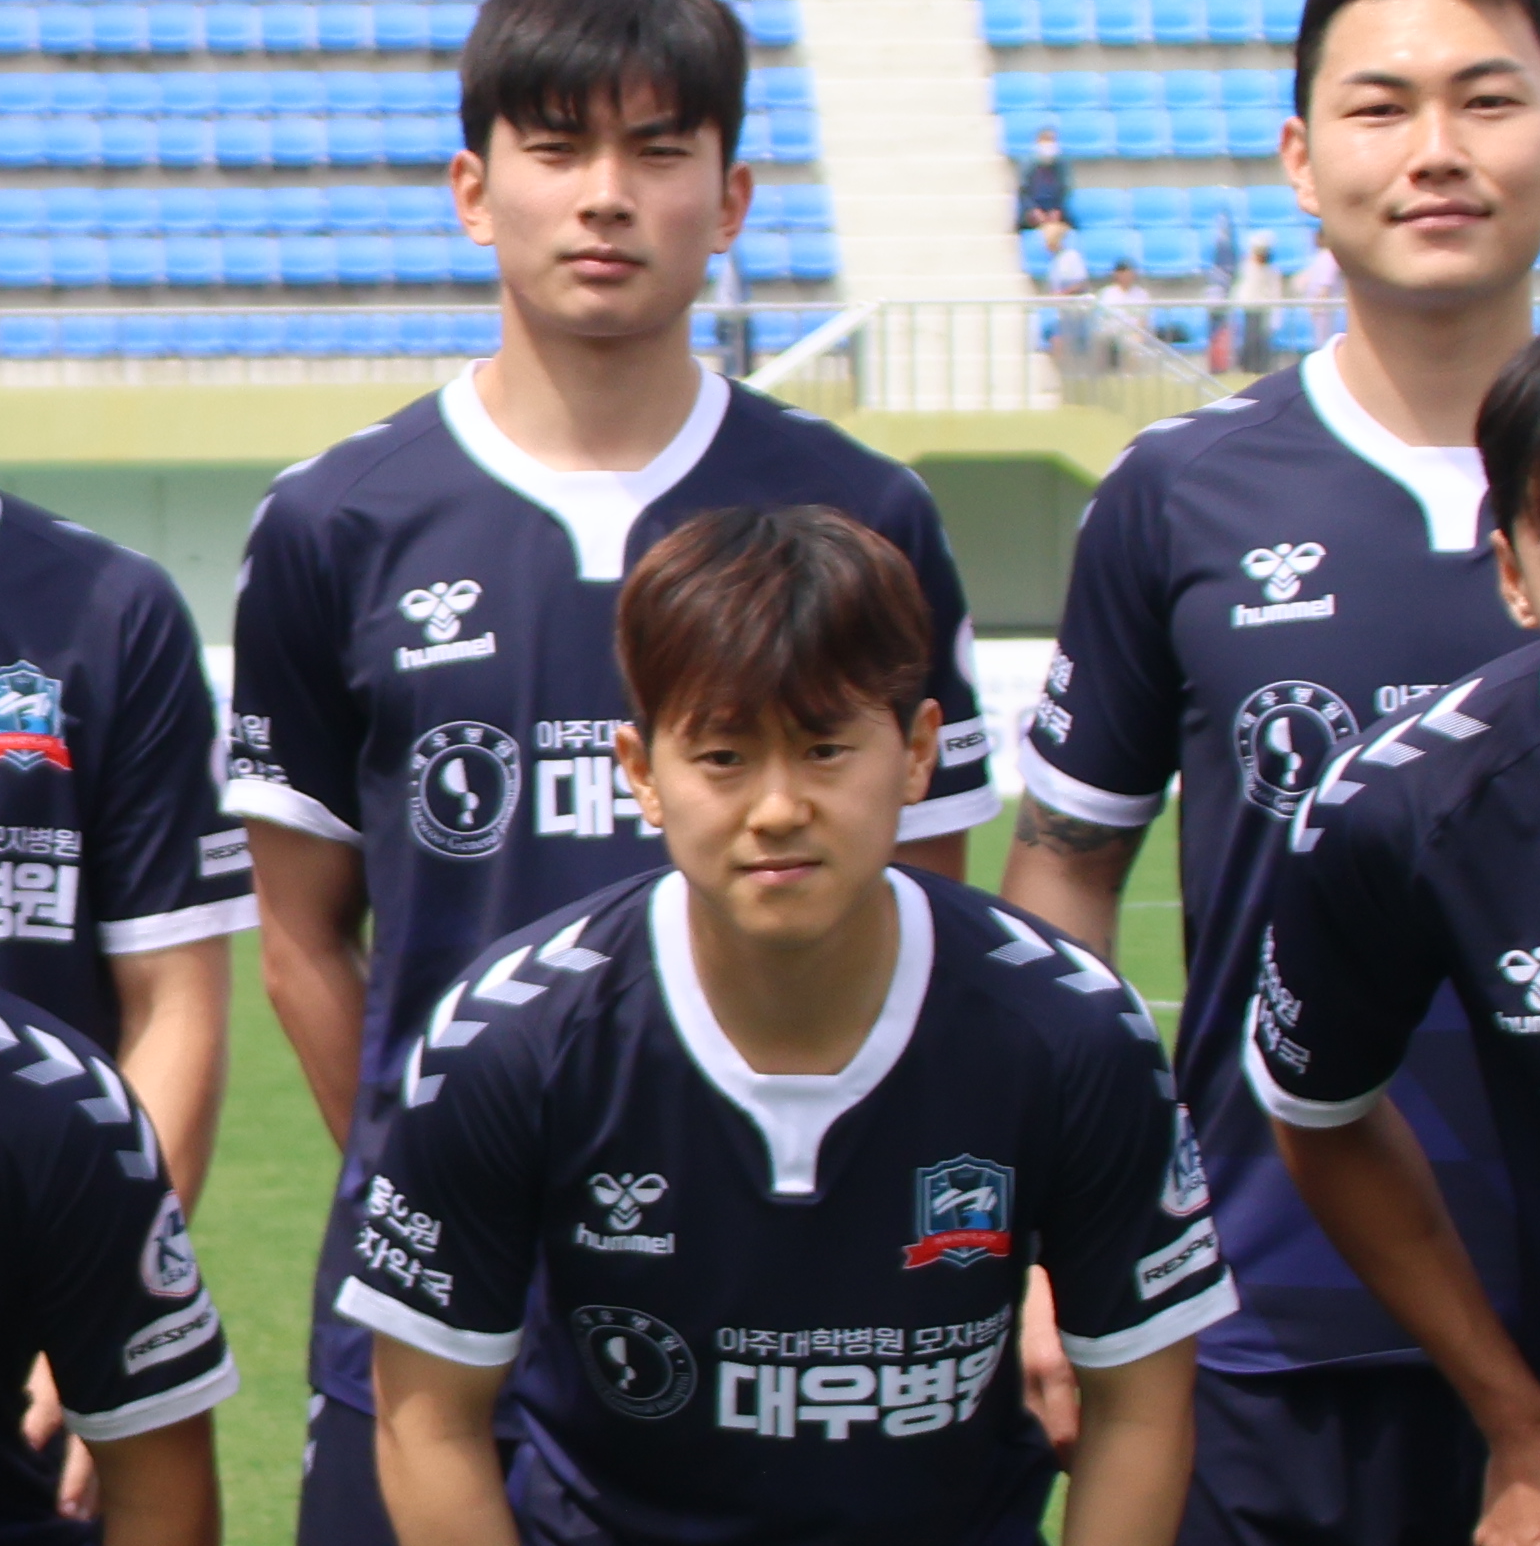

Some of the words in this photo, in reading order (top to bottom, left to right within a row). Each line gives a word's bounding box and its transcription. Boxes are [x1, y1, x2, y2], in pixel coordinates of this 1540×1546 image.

[1231, 595, 1335, 628] hummel
[396, 631, 497, 671] hummel
[536, 719, 634, 750] 아주대
[574, 1223, 675, 1254] hummel
[718, 1327, 906, 1358] 아주대학병원
